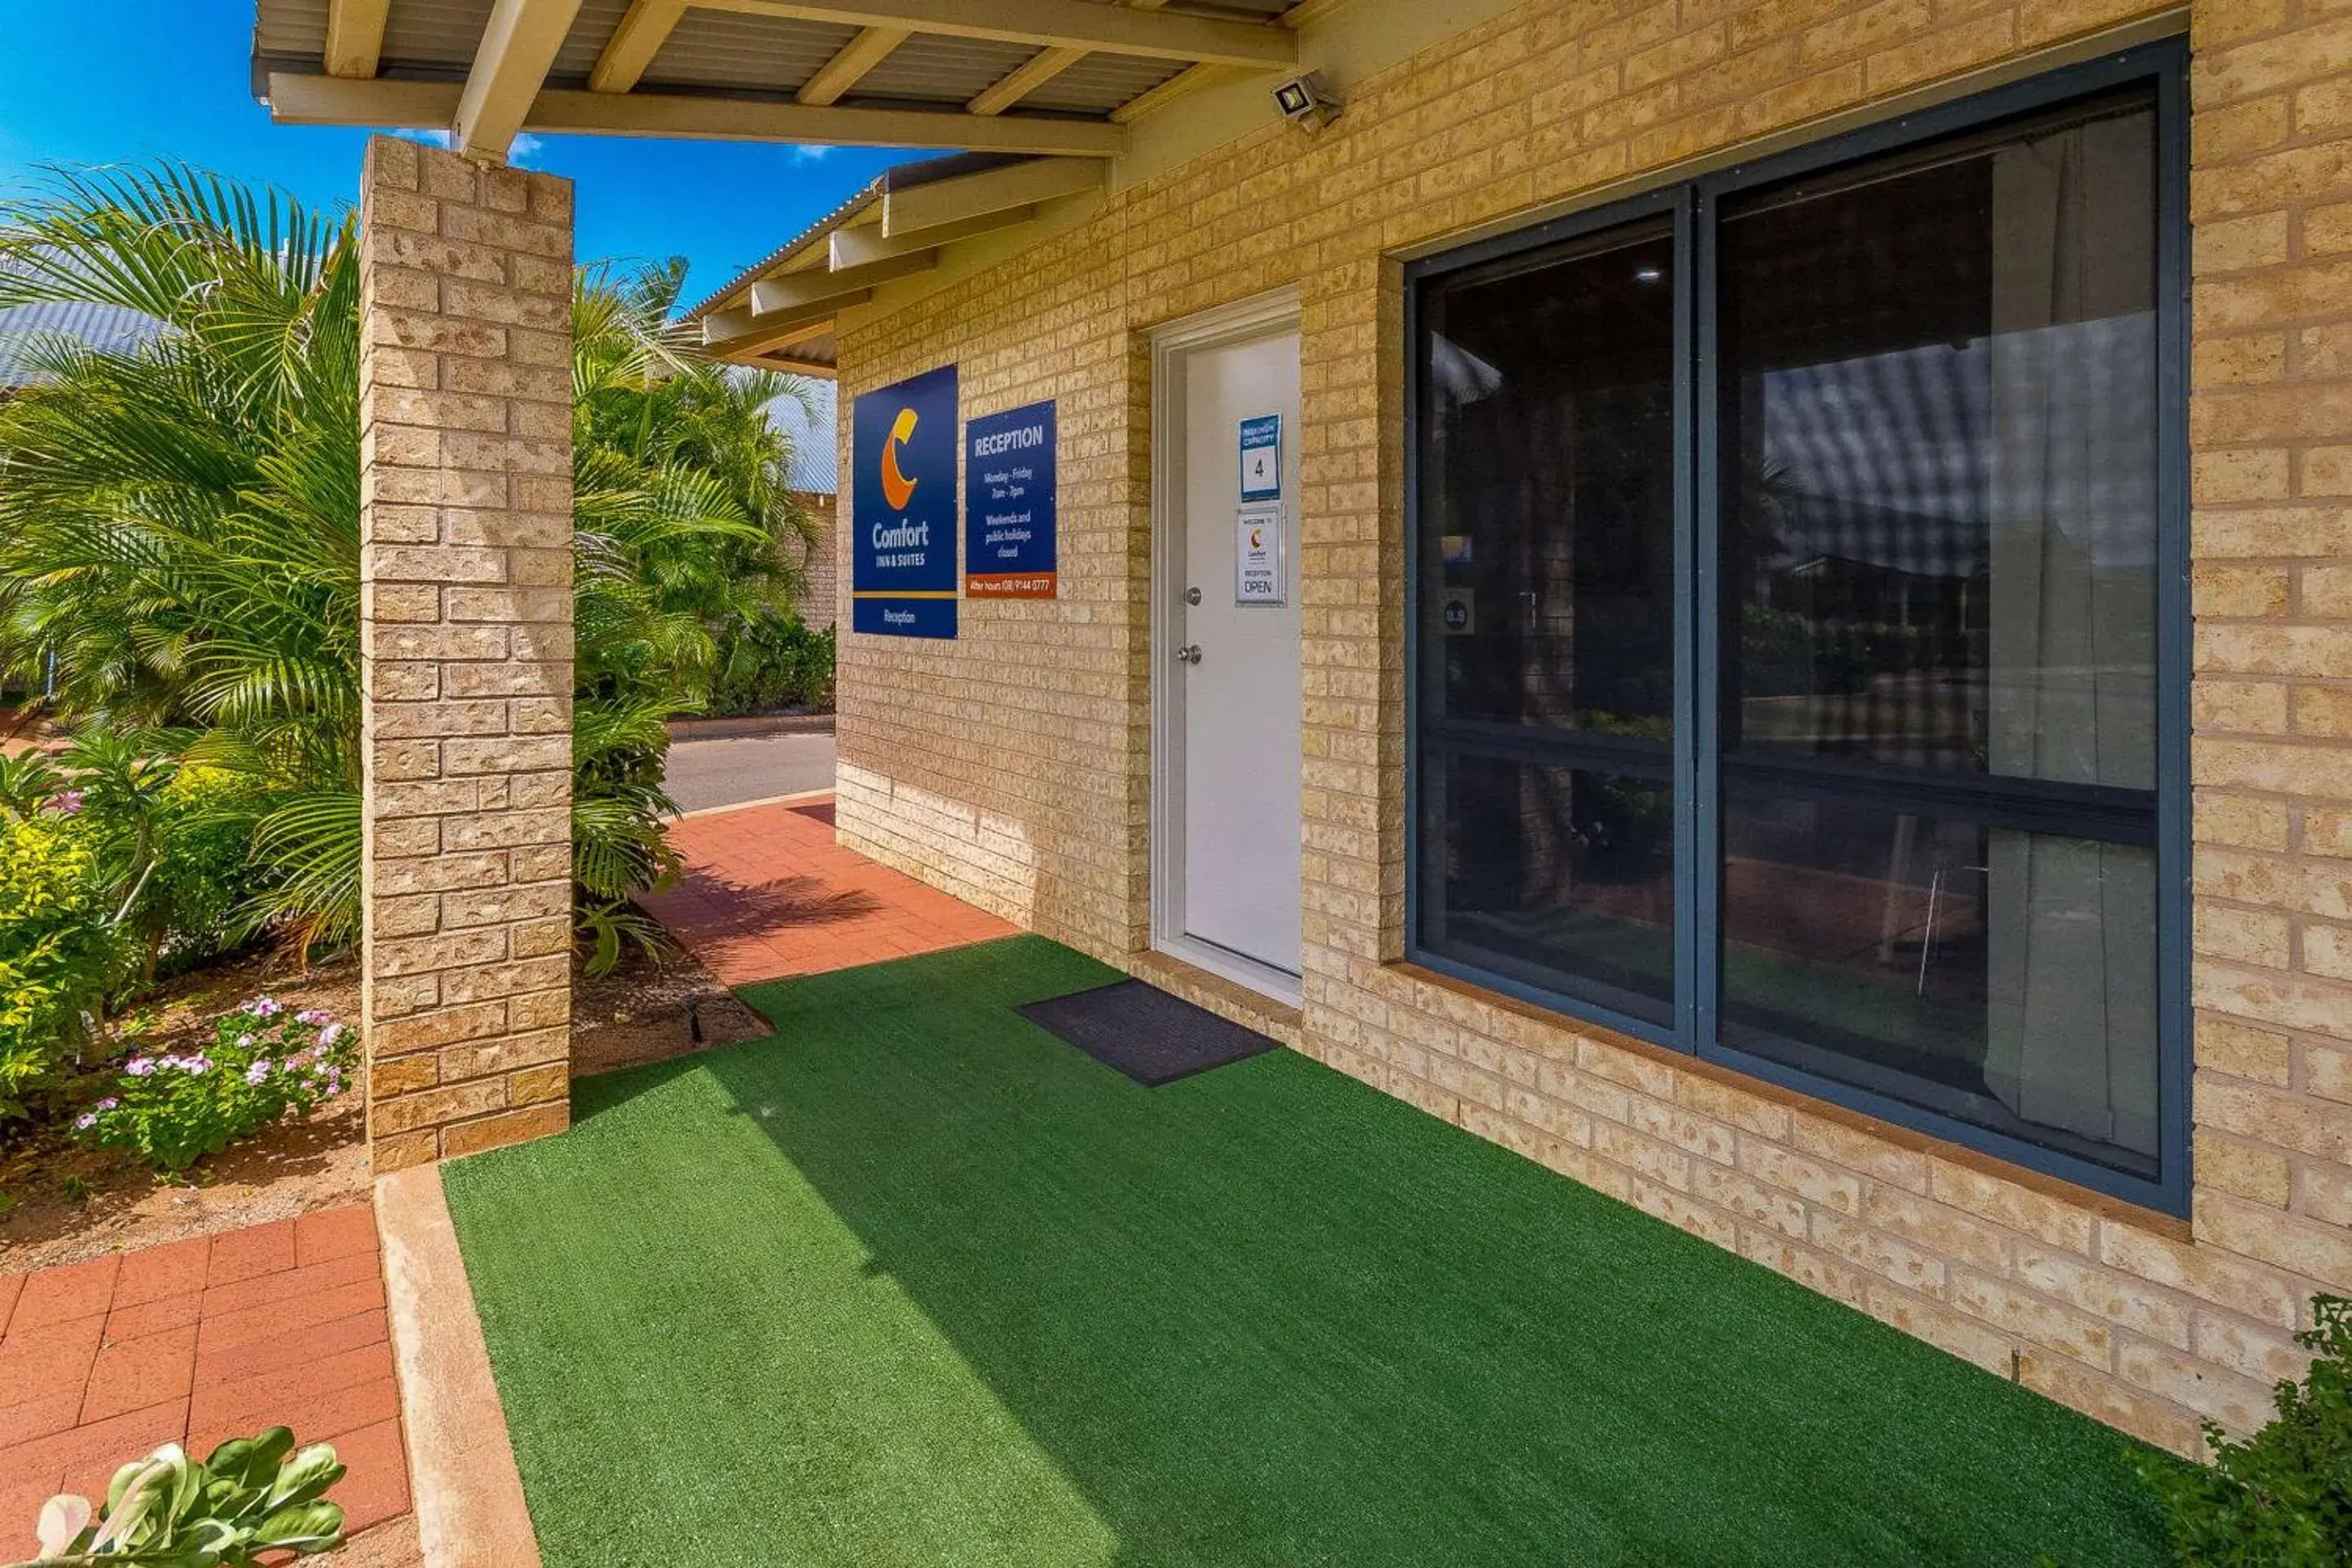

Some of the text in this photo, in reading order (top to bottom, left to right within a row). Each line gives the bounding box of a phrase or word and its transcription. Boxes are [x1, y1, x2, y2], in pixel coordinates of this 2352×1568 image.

[975, 425, 1043, 457] RECEPTION
[984, 470, 1008, 483] Monday
[1013, 466, 1032, 480] Friday
[1255, 458, 1264, 478] 4
[992, 488, 1005, 500] 7am
[1009, 486, 1024, 499] 7pm
[986, 510, 1031, 526] Weekends and
[872, 518, 929, 550] Comfort
[986, 528, 1031, 546] public holidays
[998, 545, 1018, 558] closed
[876, 553, 925, 568] INN & SUITES
[970, 581, 983, 590] After
[1245, 581, 1271, 593] OPEN
[884, 609, 916, 626] Reception
